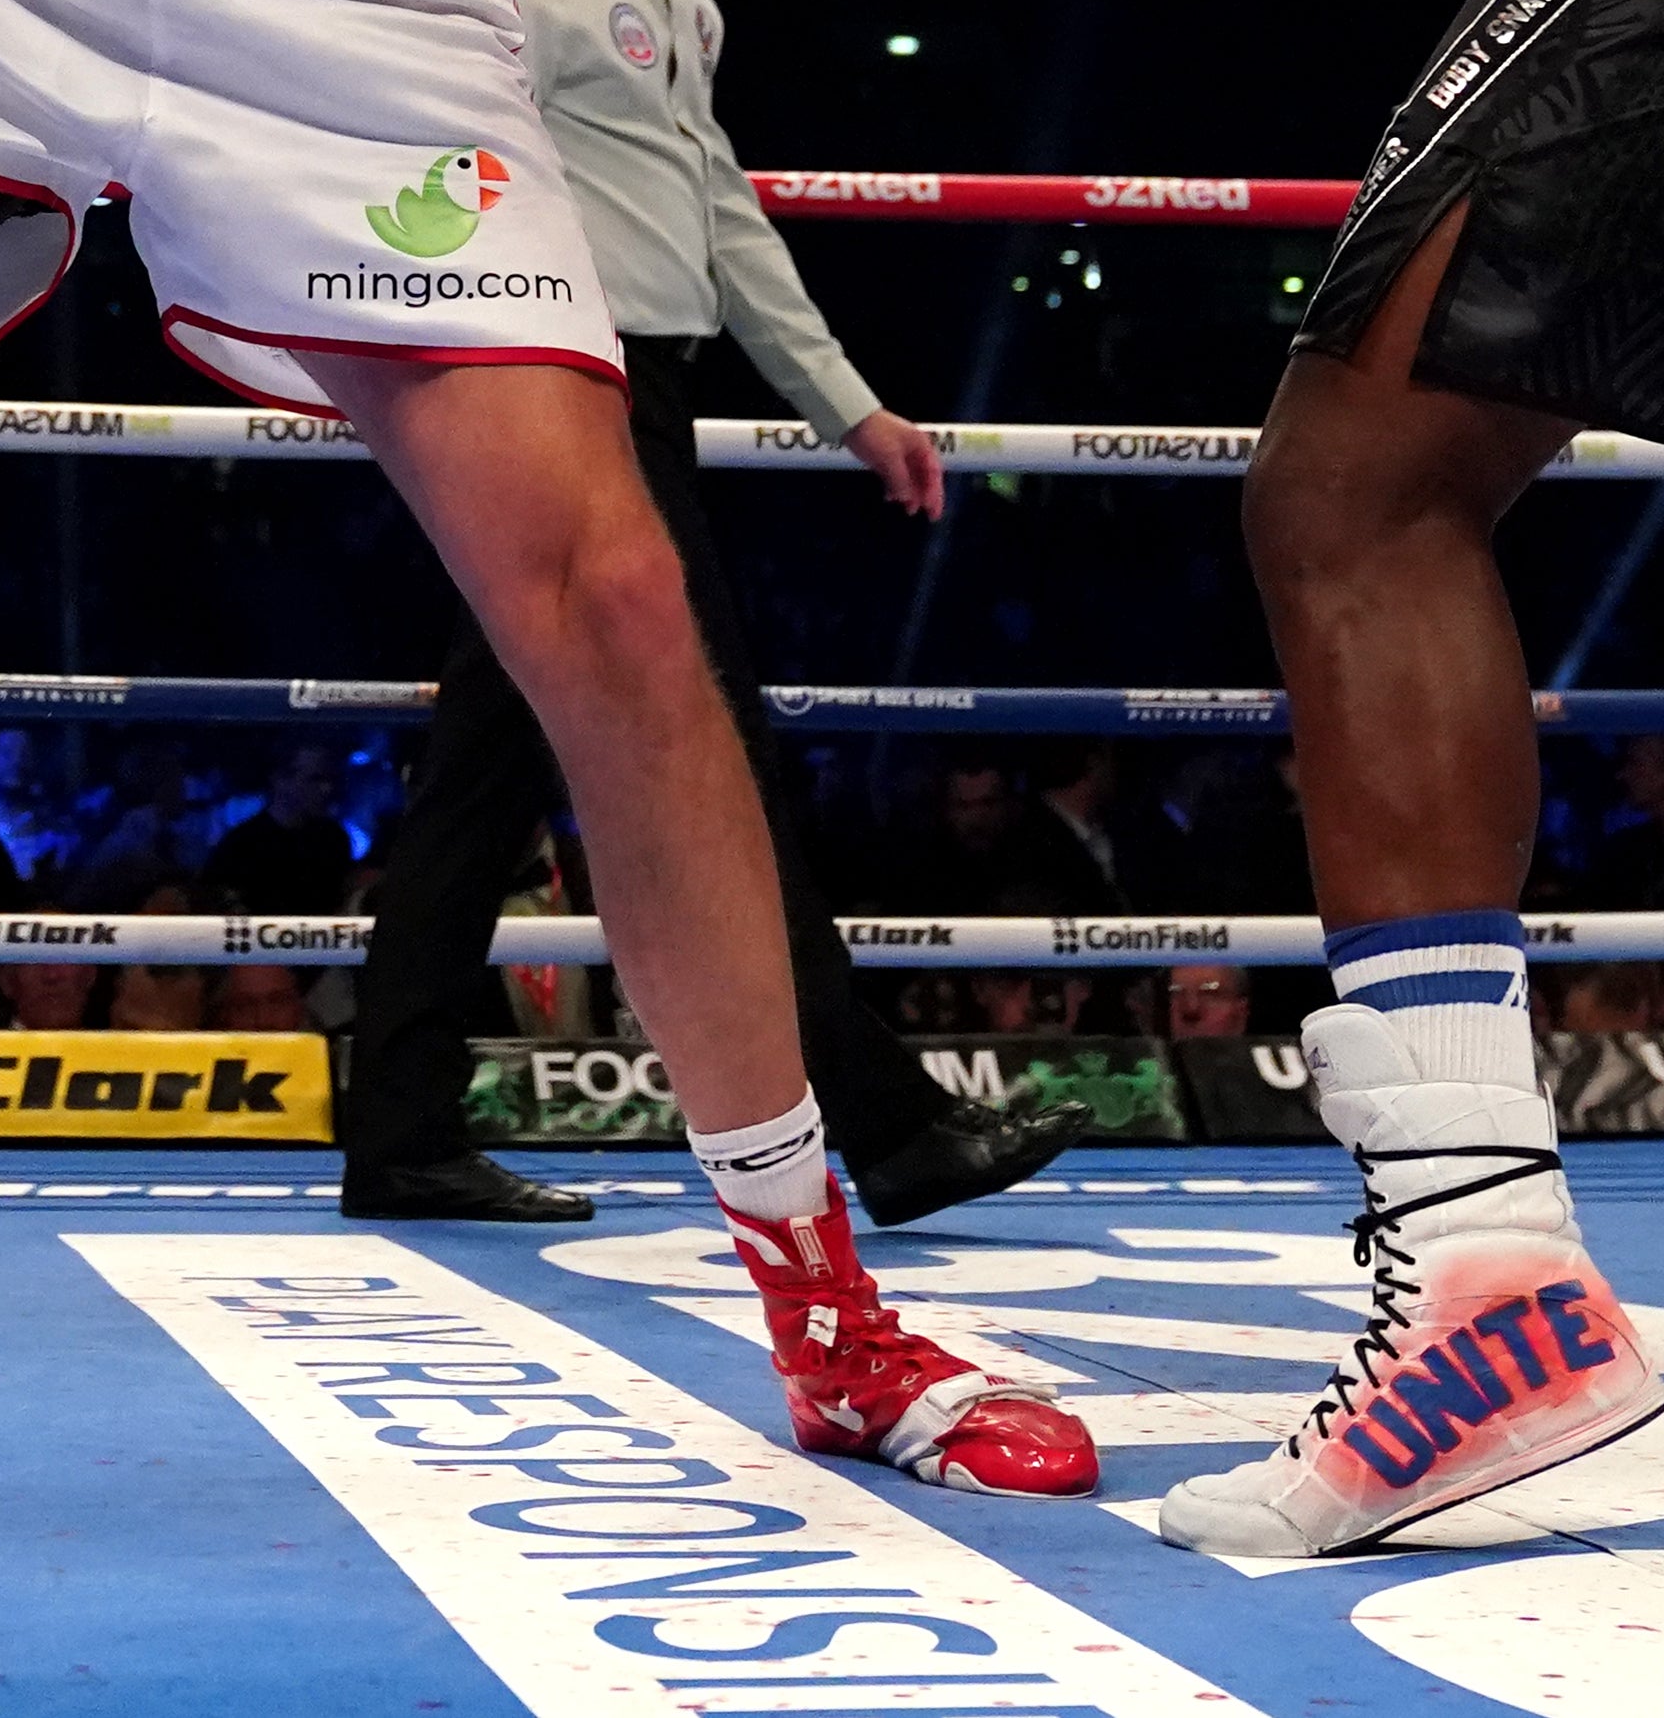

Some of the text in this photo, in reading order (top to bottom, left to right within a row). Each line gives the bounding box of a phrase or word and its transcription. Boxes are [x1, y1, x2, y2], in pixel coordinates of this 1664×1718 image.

[1426, 39, 1493, 110] BODY
[307, 261, 574, 308] mingo.com
[5, 920, 119, 946] Clark
[1084, 923, 1229, 951] CoinField
[184, 1275, 513, 1348] PLAY
[1342, 1279, 1617, 1489] UNITE
